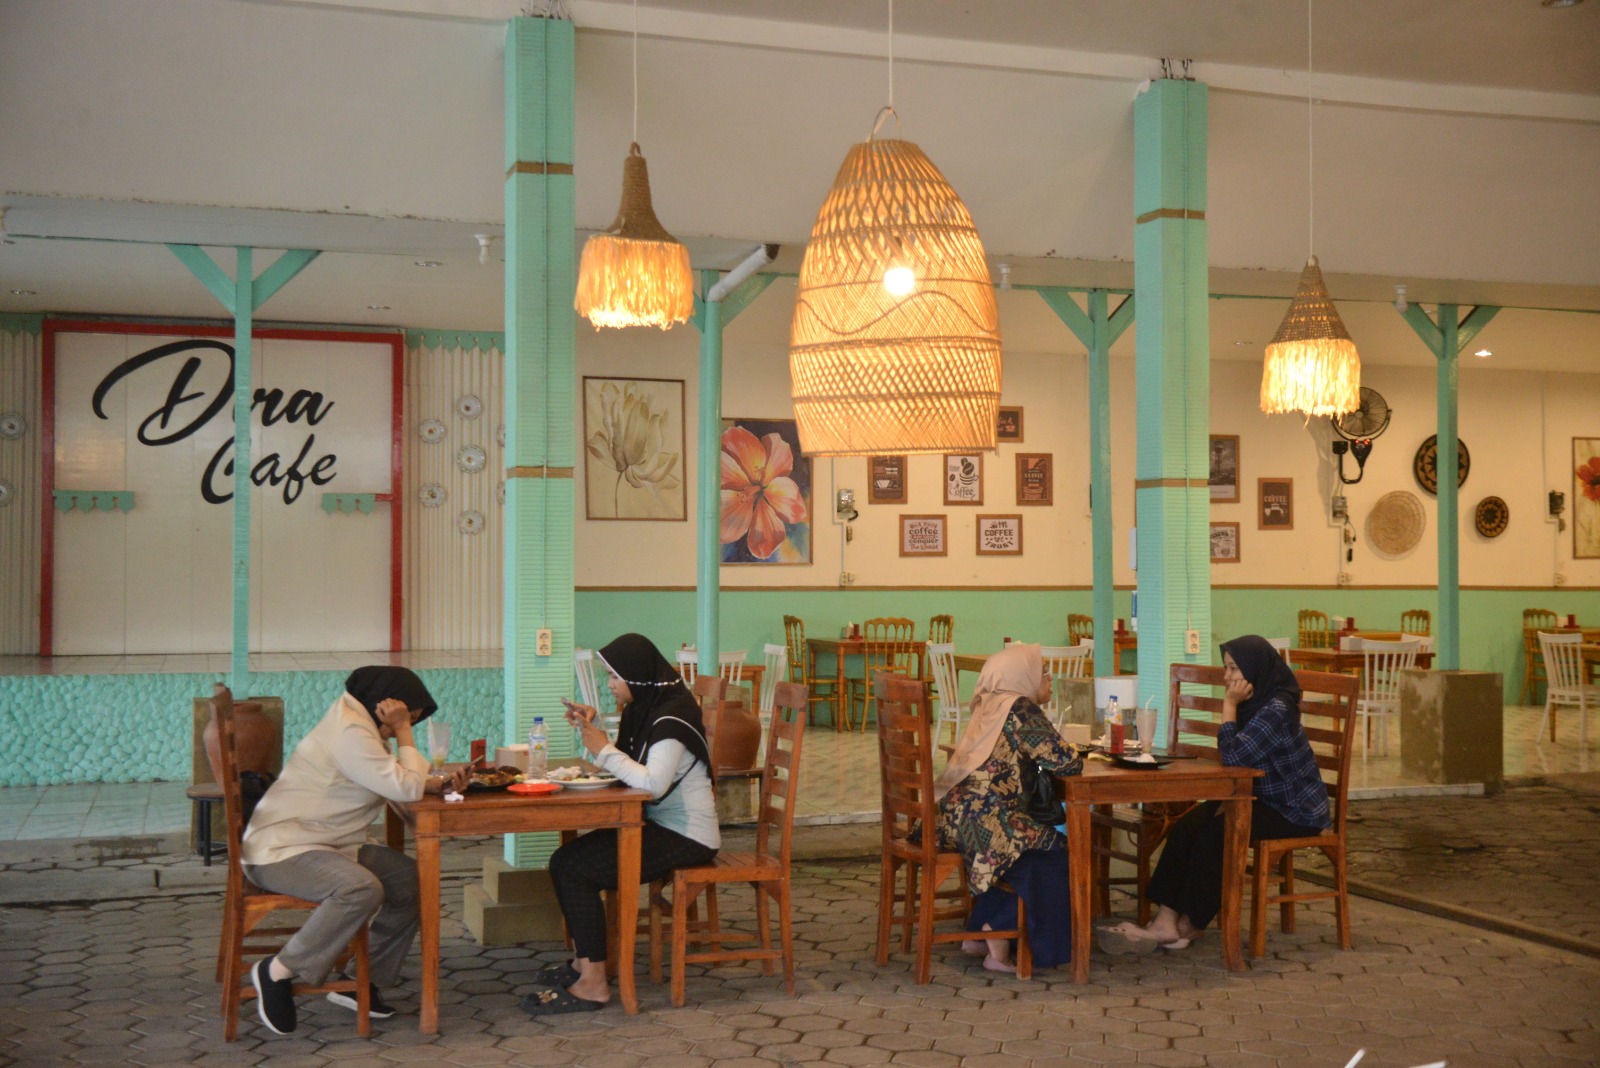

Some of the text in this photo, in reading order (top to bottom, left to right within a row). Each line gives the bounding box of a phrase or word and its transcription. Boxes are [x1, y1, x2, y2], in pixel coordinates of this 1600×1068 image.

[92, 339, 334, 446] Dra
[201, 433, 337, 505] Cafe
[949, 487, 975, 498] Coffee
[909, 527, 938, 535] coffee
[984, 529, 1014, 537] COFFEE
[985, 541, 1014, 549] TRUST
